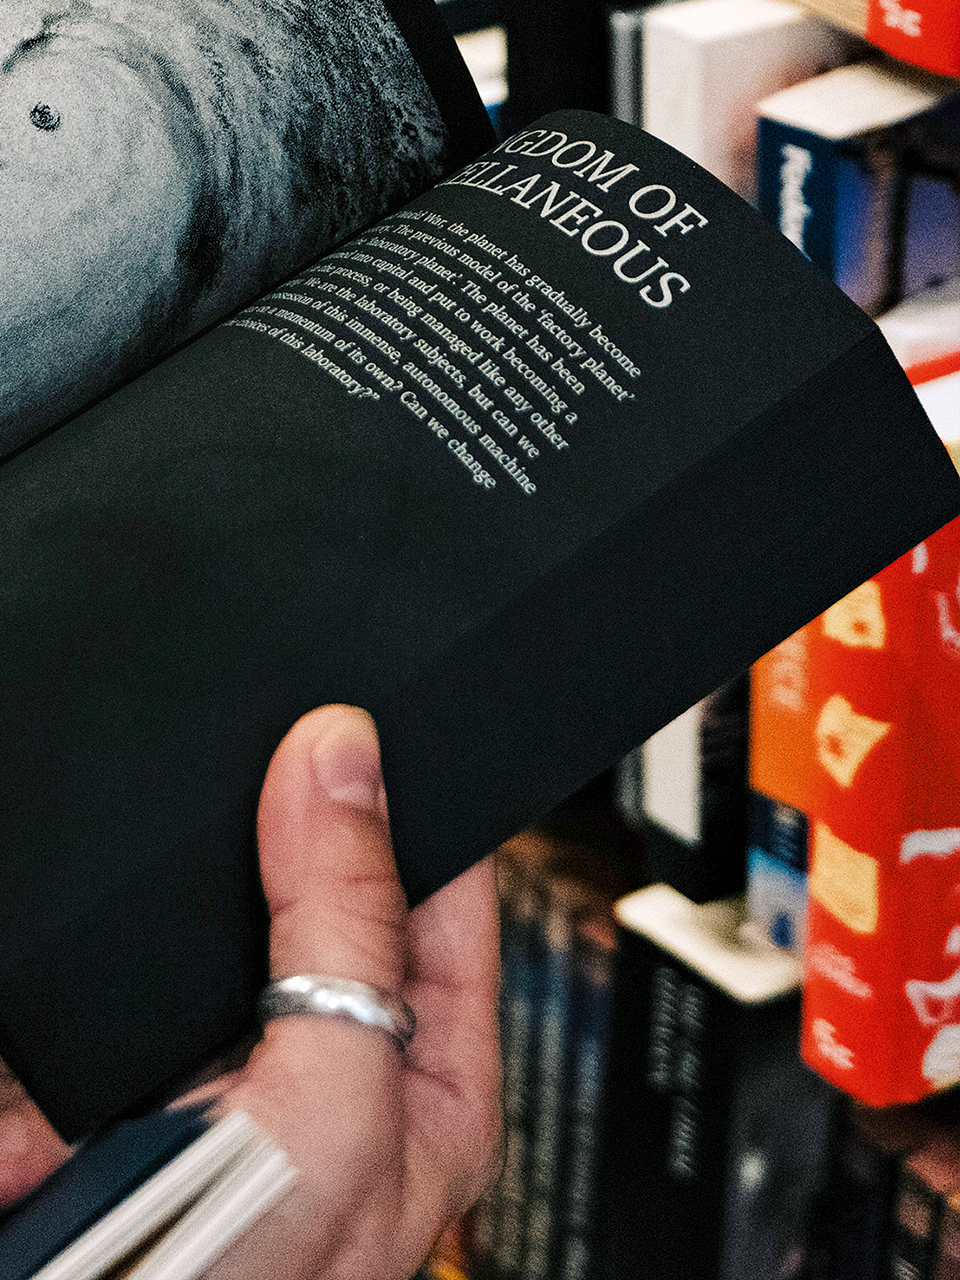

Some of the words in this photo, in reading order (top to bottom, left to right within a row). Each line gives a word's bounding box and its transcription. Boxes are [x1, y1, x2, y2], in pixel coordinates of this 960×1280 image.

[628, 184, 709, 238] OF
[267, 327, 289, 338] of
[279, 332, 306, 350] this
[301, 343, 381, 401] laboratory?”
[317, 281, 338, 293] are
[335, 286, 357, 302] the
[353, 294, 418, 341] laboratory
[413, 338, 467, 389] subjects,
[468, 383, 495, 412] but
[492, 409, 519, 438] can
[517, 434, 540, 459] we
[328, 266, 373, 288] process,
[373, 281, 390, 294] or
[387, 287, 424, 318] being
[420, 312, 485, 365] managed
[477, 358, 507, 387] like
[503, 386, 534, 412] any
[530, 412, 569, 450] other
[371, 258, 414, 280] capital
[407, 276, 438, 296] and
[428, 291, 458, 312] put
[453, 307, 471, 322] to
[469, 320, 506, 353] work
[502, 346, 568, 415] becoming
[564, 411, 579, 426] a
[392, 224, 414, 236] The
[407, 230, 460, 257] previous
[457, 253, 502, 283] model
[496, 280, 520, 295] of
[511, 290, 537, 313] the
[537, 308, 587, 358] ‘factory
[579, 357, 636, 403] planet’
[447, 222, 469, 237] the
[462, 234, 509, 261] planet
[504, 254, 531, 277] has
[525, 274, 592, 328] gradually
[588, 324, 642, 378] become
[461, 280, 488, 304] The
[481, 301, 529, 339] planet
[525, 334, 553, 363] has
[551, 357, 586, 397] been
[275, 308, 336, 343] momentum
[334, 338, 354, 353] of
[347, 346, 368, 365] its
[365, 361, 404, 392] own?
[400, 390, 429, 420] Can
[426, 416, 450, 440] we
[447, 438, 497, 490] change
[311, 300, 332, 311] of
[323, 305, 349, 323] this
[345, 315, 402, 366] immense,
[402, 361, 482, 436] autonomous
[478, 433, 537, 495] machine
